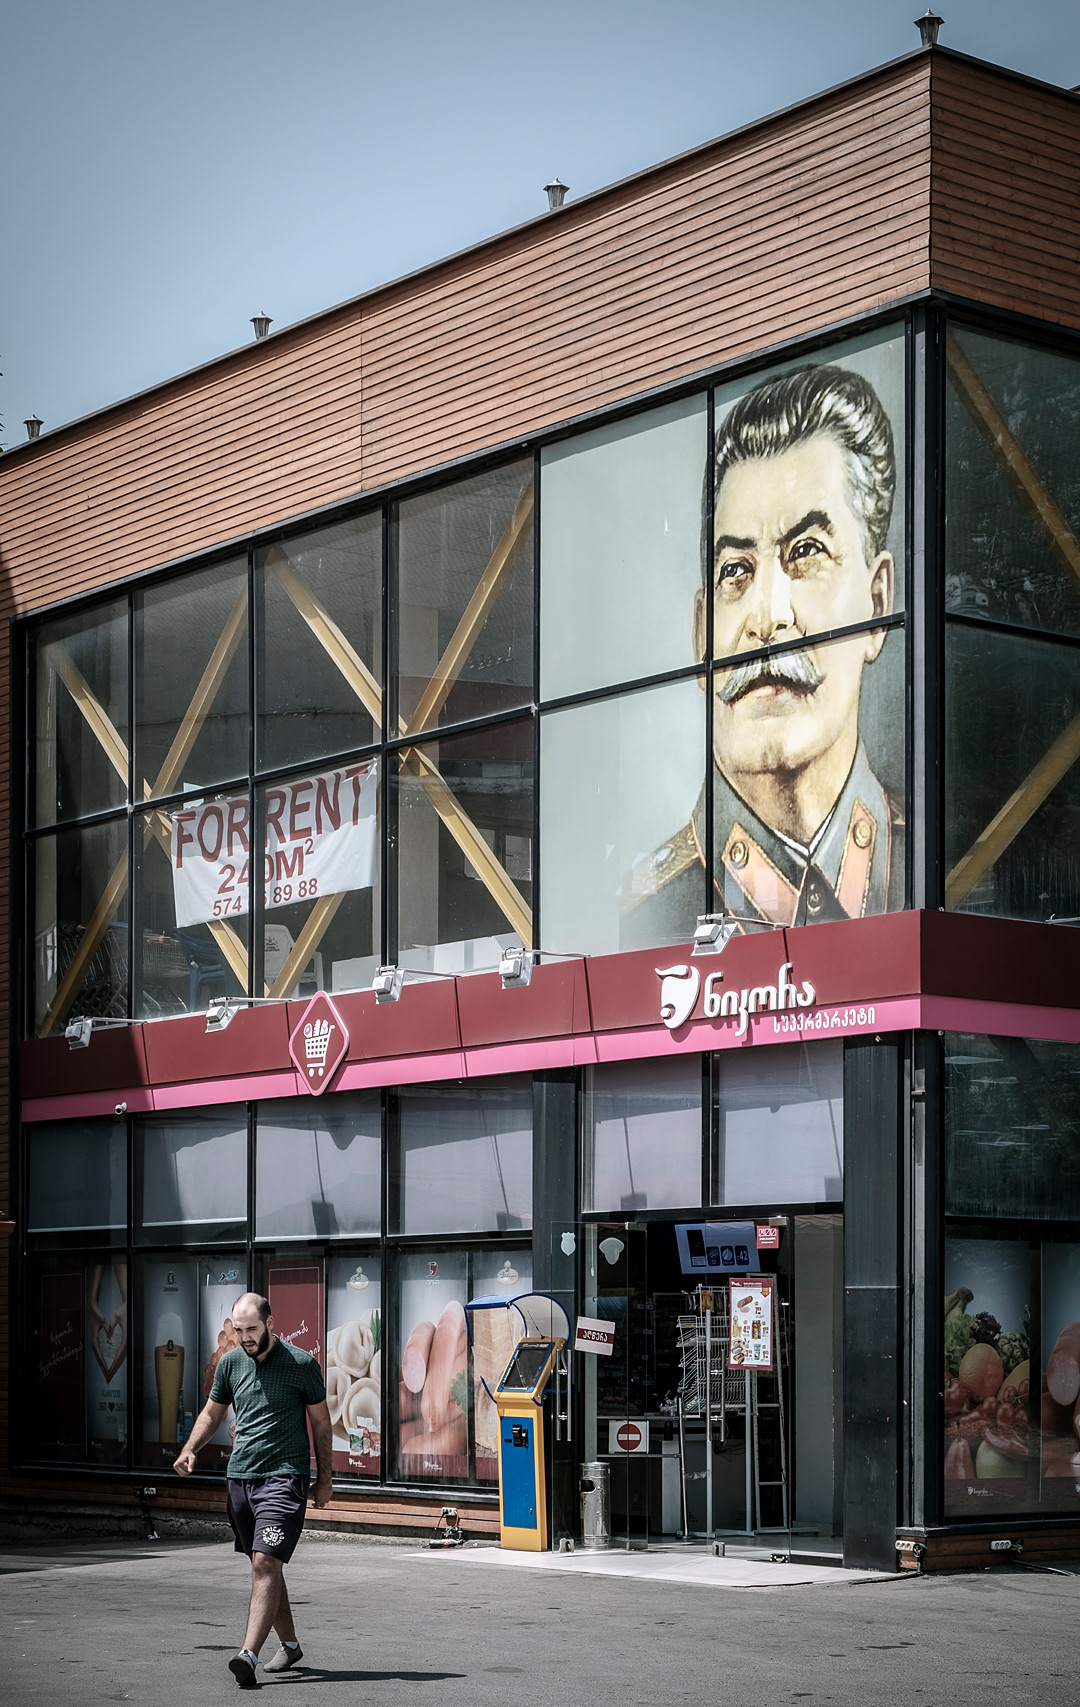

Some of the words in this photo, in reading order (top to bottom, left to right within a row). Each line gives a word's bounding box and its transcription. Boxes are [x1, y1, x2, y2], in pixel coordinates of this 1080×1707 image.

[176, 799, 249, 869] FOR
[265, 765, 368, 846] RENT
[212, 895, 242, 917] 574
[273, 884, 292, 904] 89
[298, 877, 318, 898] 88
[773, 1006, 876, 1034] სუპერმარკეტი
[267, 1532, 279, 1542] 38
